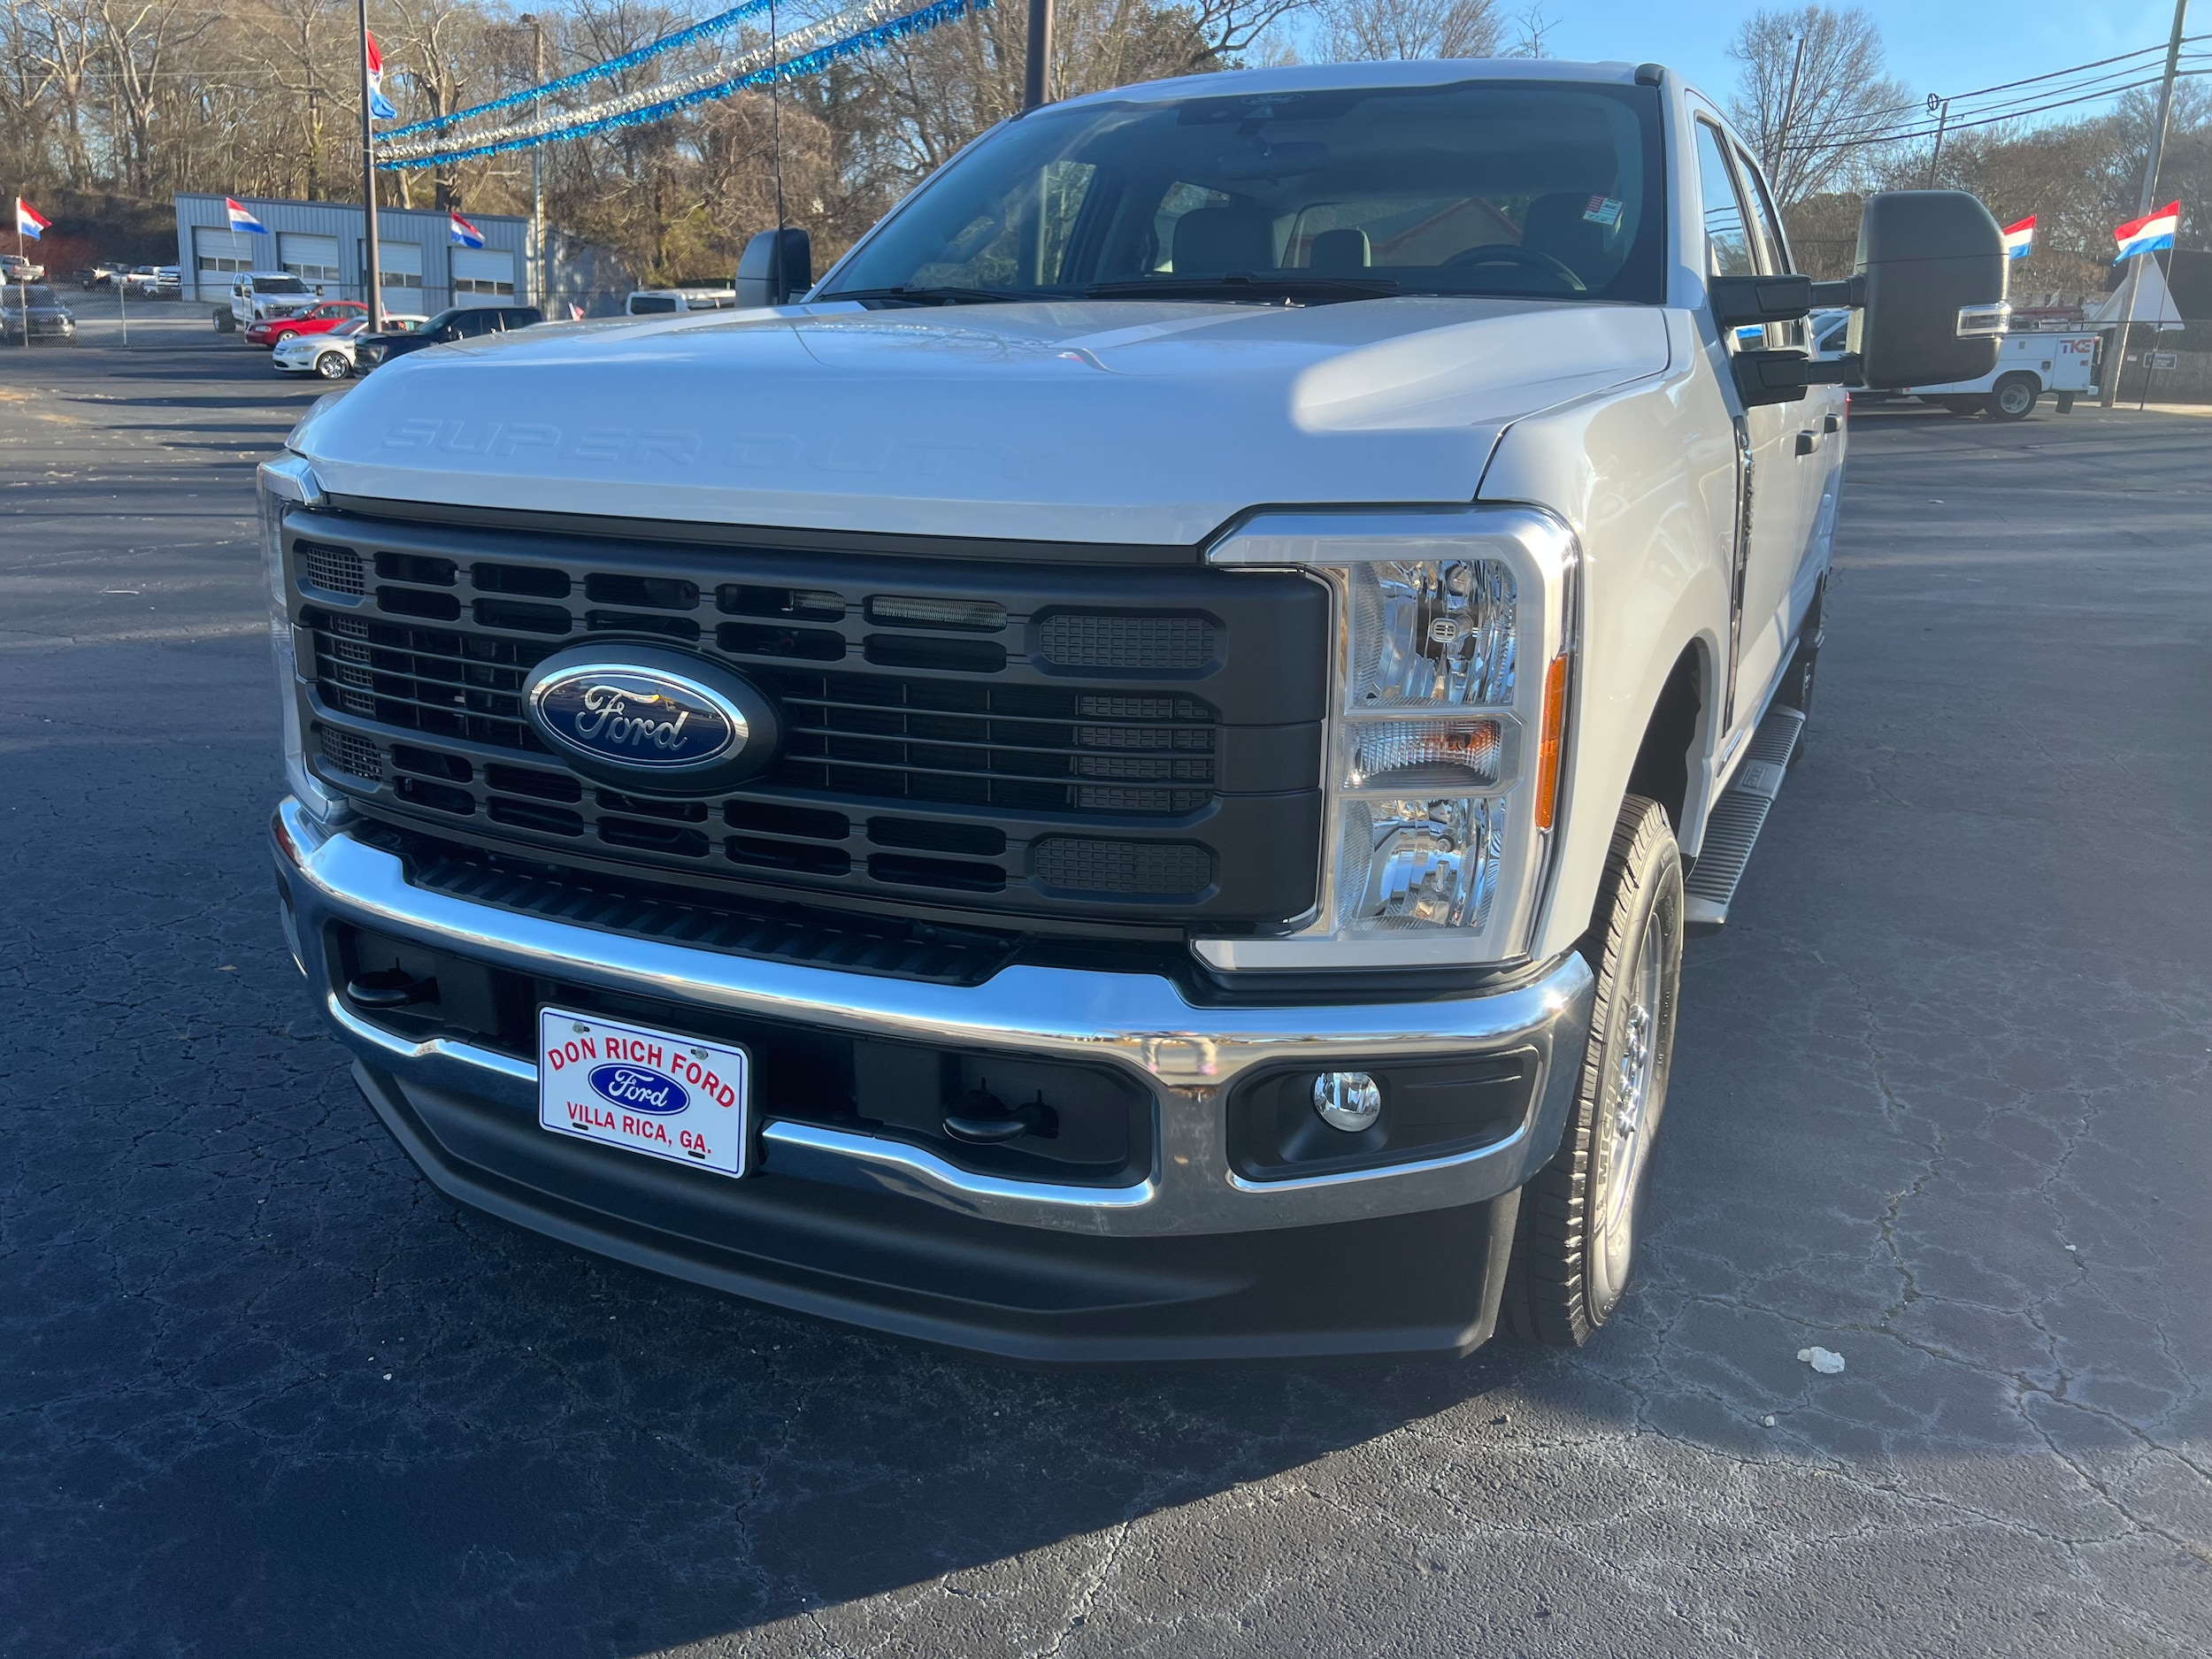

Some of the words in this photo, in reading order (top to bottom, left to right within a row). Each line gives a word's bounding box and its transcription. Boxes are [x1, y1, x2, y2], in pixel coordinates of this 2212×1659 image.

[2060, 339, 2093, 354] TKE
[380, 418, 703, 466] SUPER
[721, 432, 1064, 480] DUTY
[575, 685, 690, 751] Ford
[547, 1037, 596, 1071] DON
[605, 1037, 663, 1068] RICH
[671, 1052, 735, 1108] FORD
[608, 1069, 668, 1107] Ford
[566, 1101, 616, 1130] VILLA
[622, 1115, 672, 1148] RICA,
[680, 1130, 711, 1154] GA.
